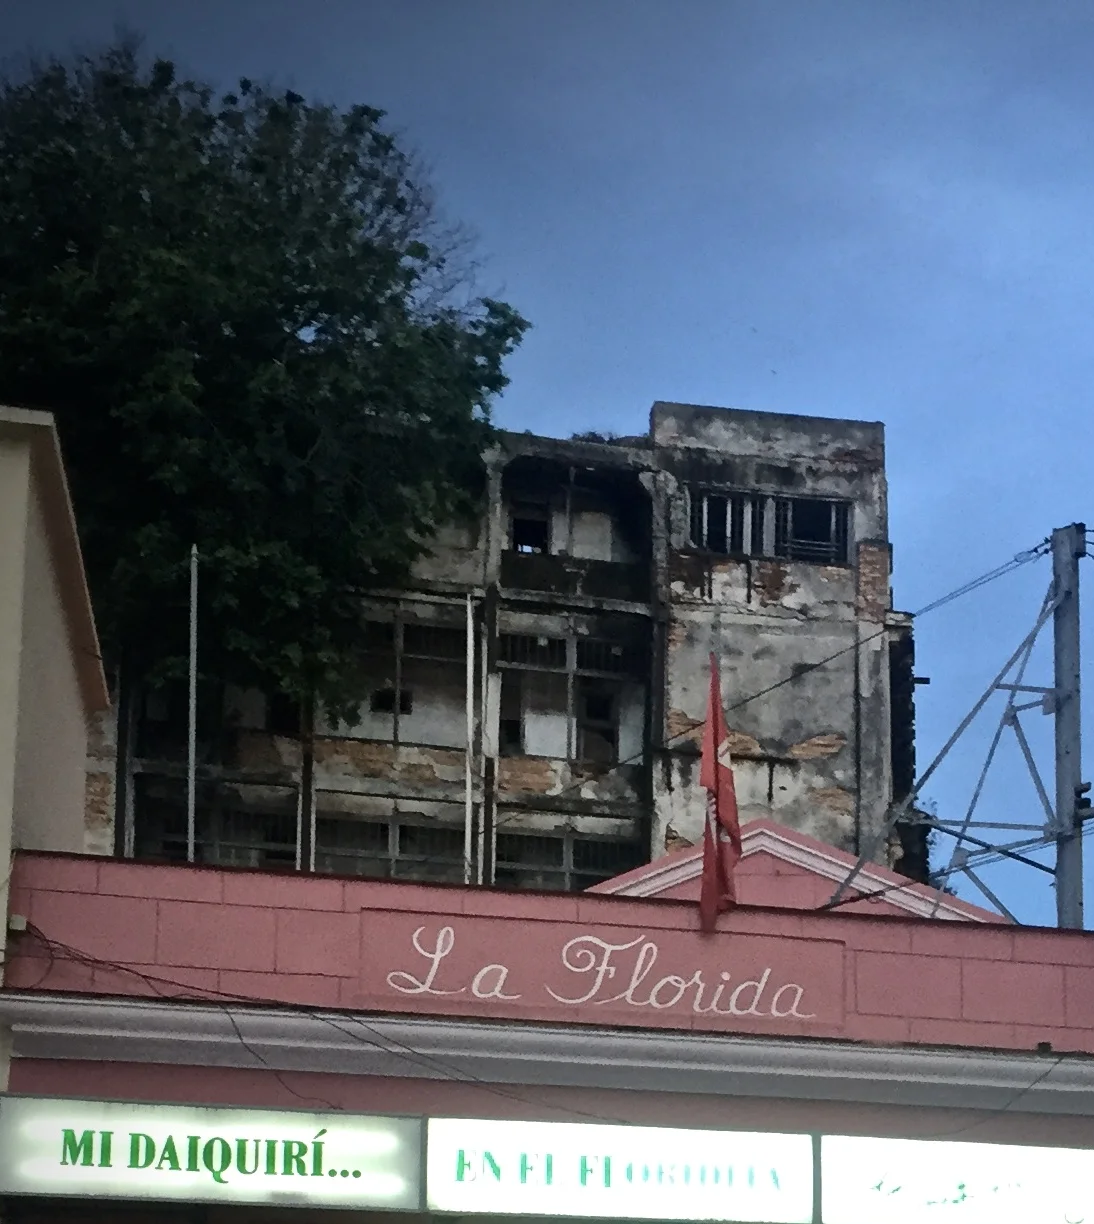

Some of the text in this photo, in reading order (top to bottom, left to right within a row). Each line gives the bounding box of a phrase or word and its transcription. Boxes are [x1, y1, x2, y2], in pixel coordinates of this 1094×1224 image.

[386, 925, 817, 1019] La Florida
[60, 1127, 114, 1169] MI
[454, 1148, 502, 1183] EN
